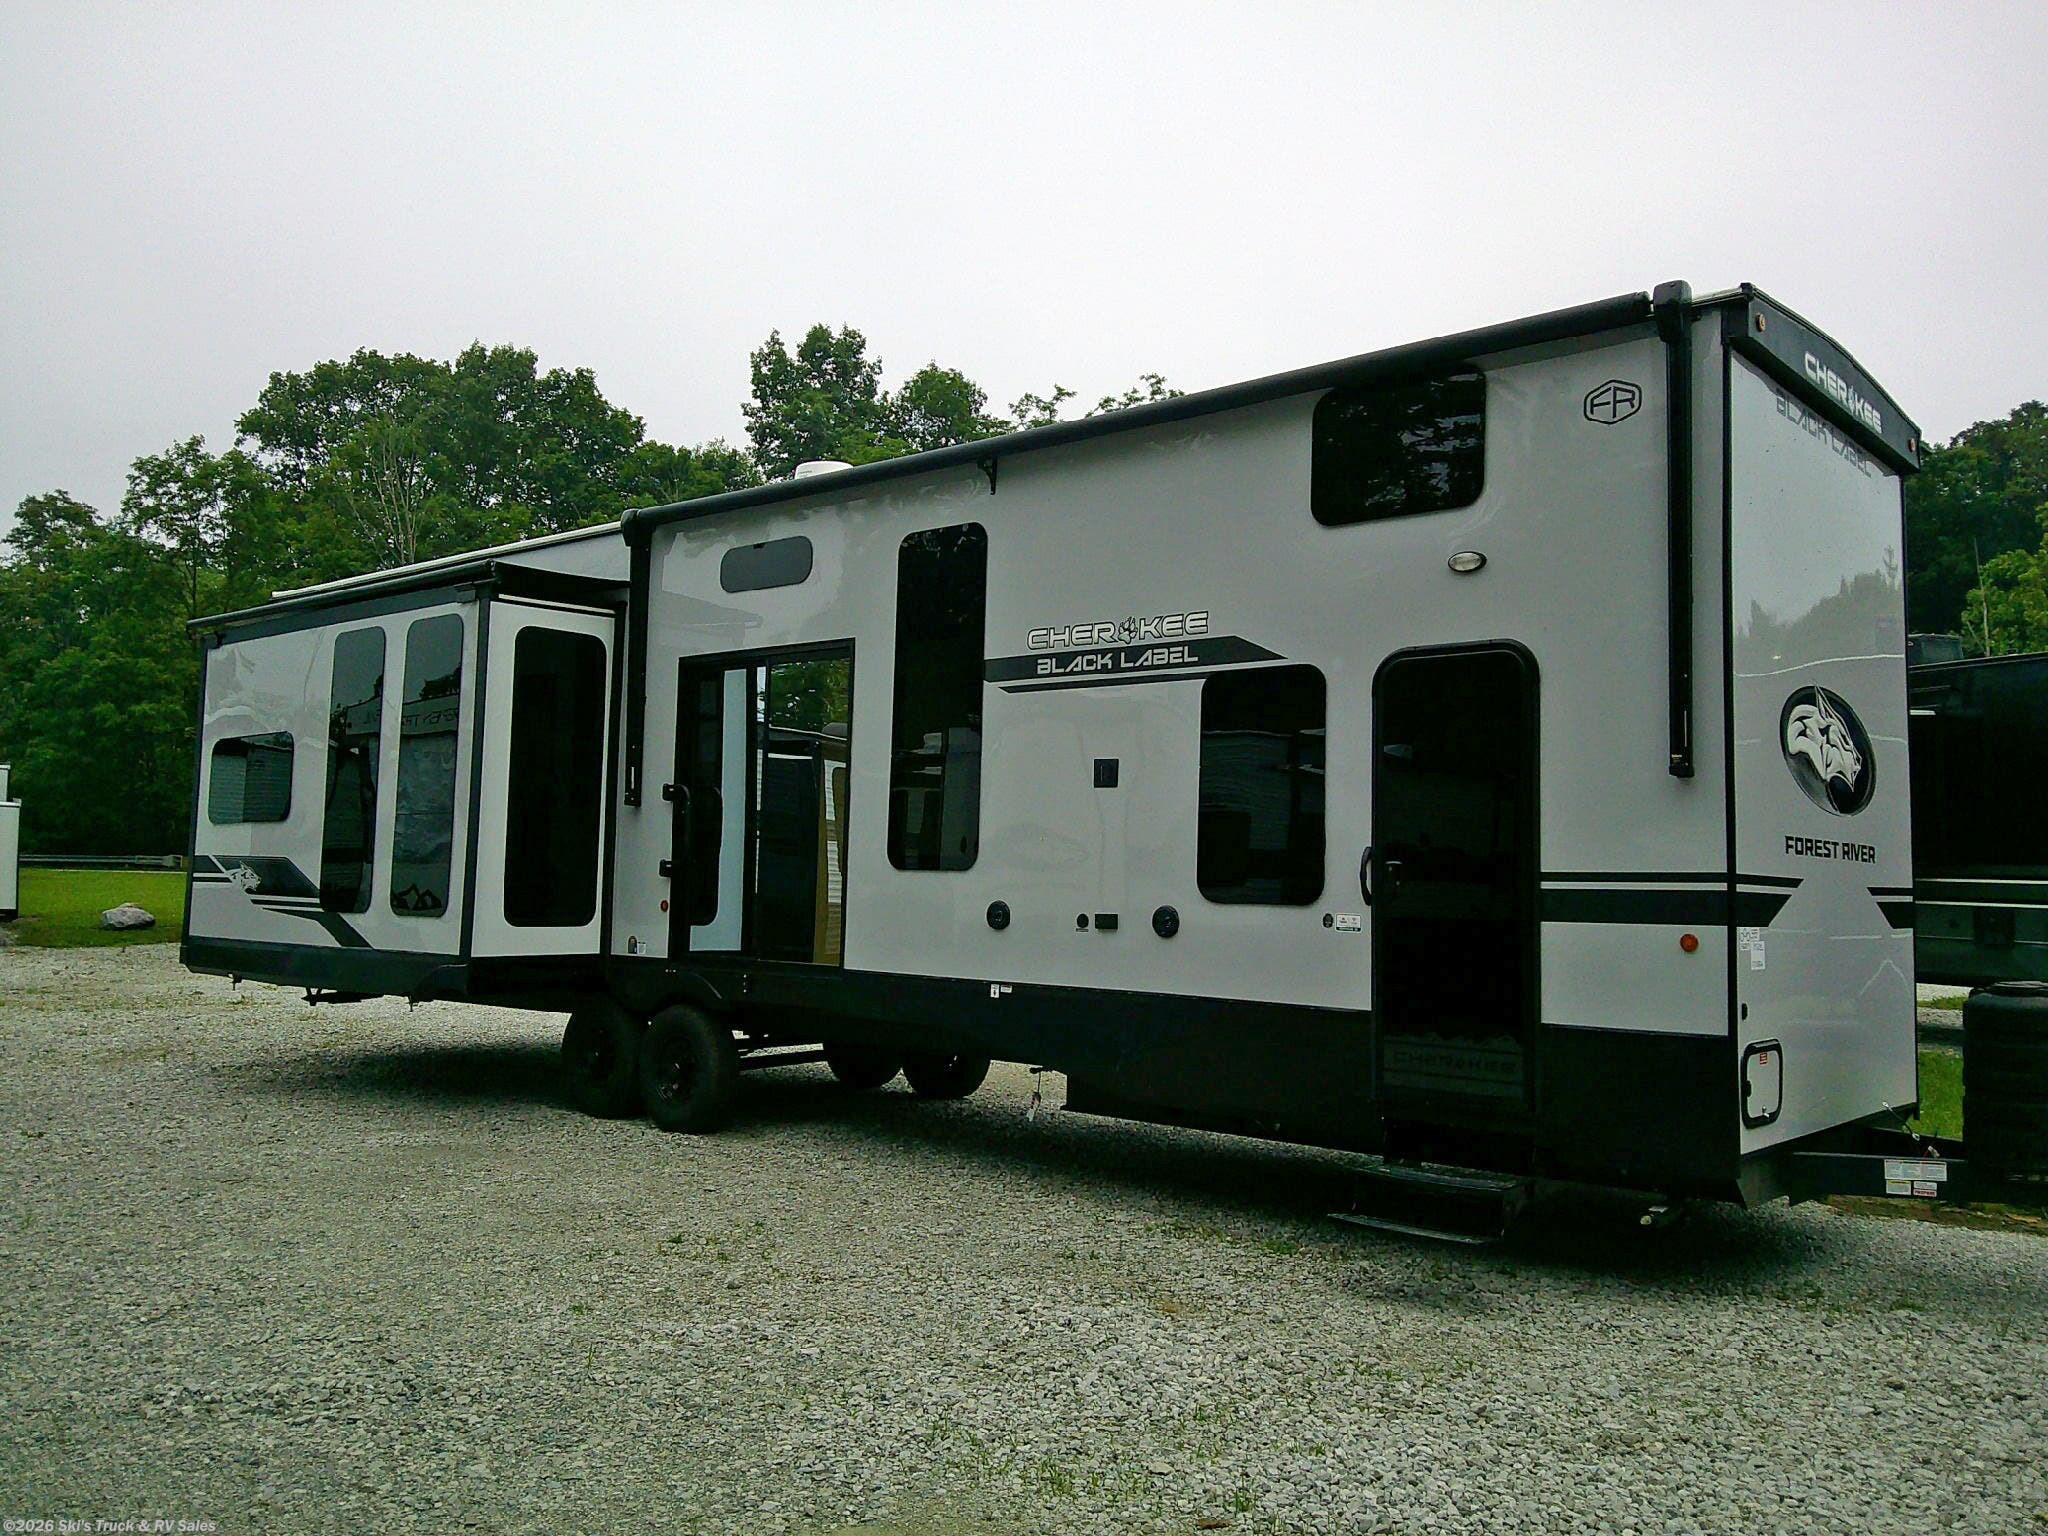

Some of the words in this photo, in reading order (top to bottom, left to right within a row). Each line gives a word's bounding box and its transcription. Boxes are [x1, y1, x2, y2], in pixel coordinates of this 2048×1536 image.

[1037, 650, 1112, 675] BLACK
[1120, 645, 1199, 667] LABEL
[1784, 835, 1840, 859] FOREST
[1841, 842, 1876, 864] RIVER
